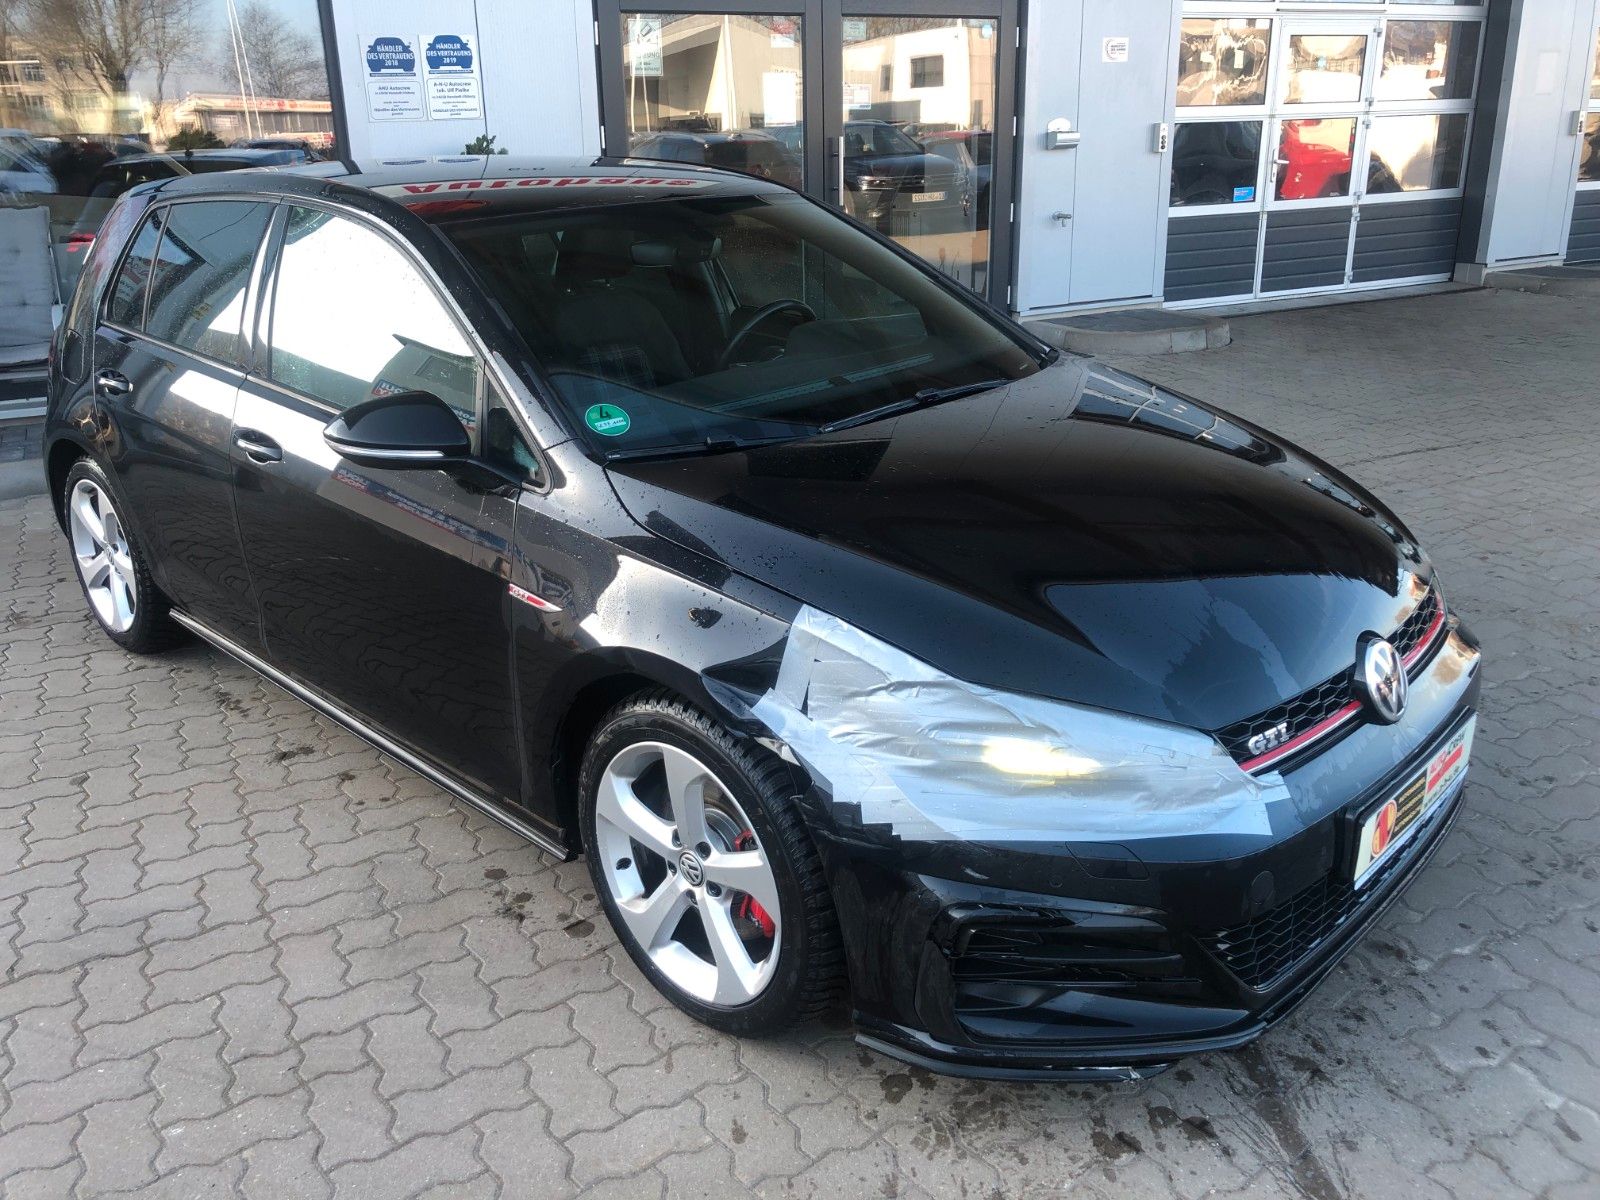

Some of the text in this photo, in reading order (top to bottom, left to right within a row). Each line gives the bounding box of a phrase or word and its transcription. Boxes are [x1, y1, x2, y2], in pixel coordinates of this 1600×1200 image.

[377, 44, 403, 52] HÄNDLER
[367, 52, 415, 60] DES VERTRAUENS
[1248, 722, 1289, 756] GTI
